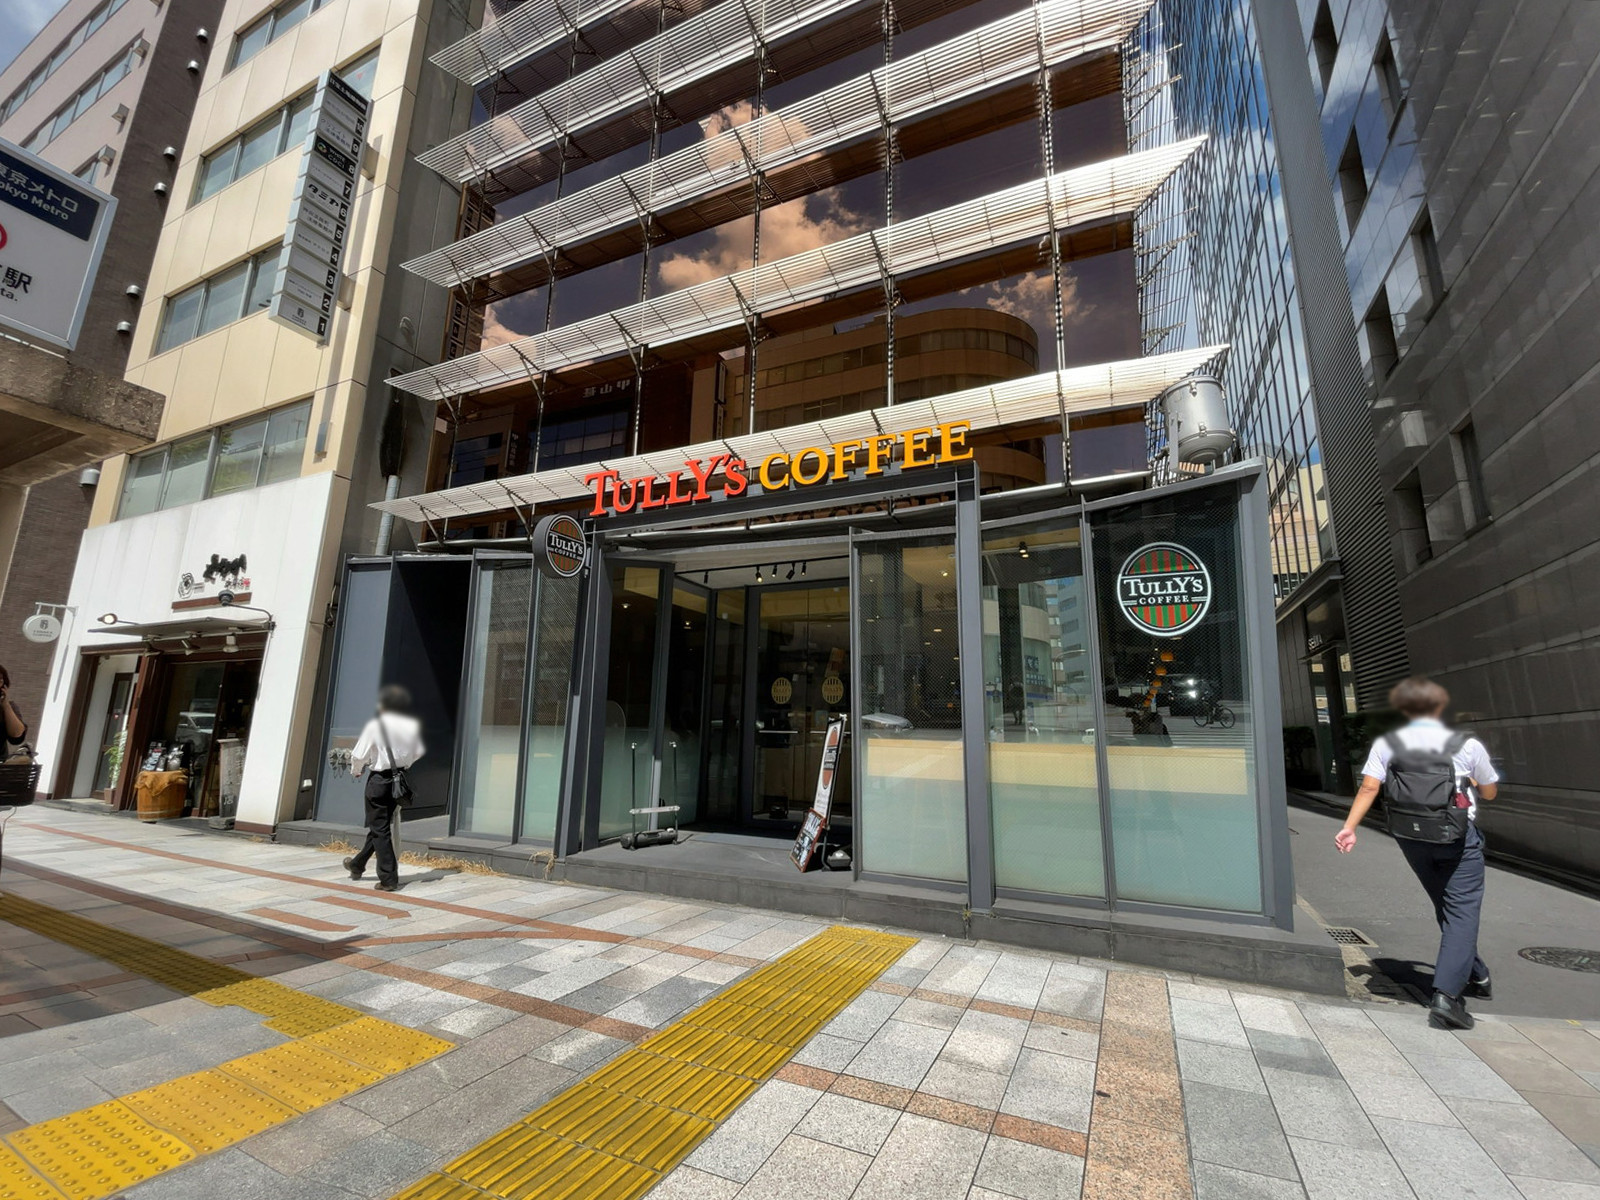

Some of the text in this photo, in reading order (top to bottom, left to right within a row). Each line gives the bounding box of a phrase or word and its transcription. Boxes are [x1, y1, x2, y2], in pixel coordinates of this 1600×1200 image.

[0, 162, 78, 213] 東京メトロ
[308, 183, 339, 207] タミヤ
[0, 181, 69, 220] okyo Metro
[0, 264, 33, 294] 駅
[0, 287, 18, 302] ta.
[584, 453, 748, 516] TULLY'S
[759, 420, 974, 490] COFFEE
[549, 532, 584, 555] TULLY'S
[554, 548, 577, 559] COFFEE
[1123, 576, 1204, 597] TULLY'S
[1139, 595, 1189, 605] COFFEE
